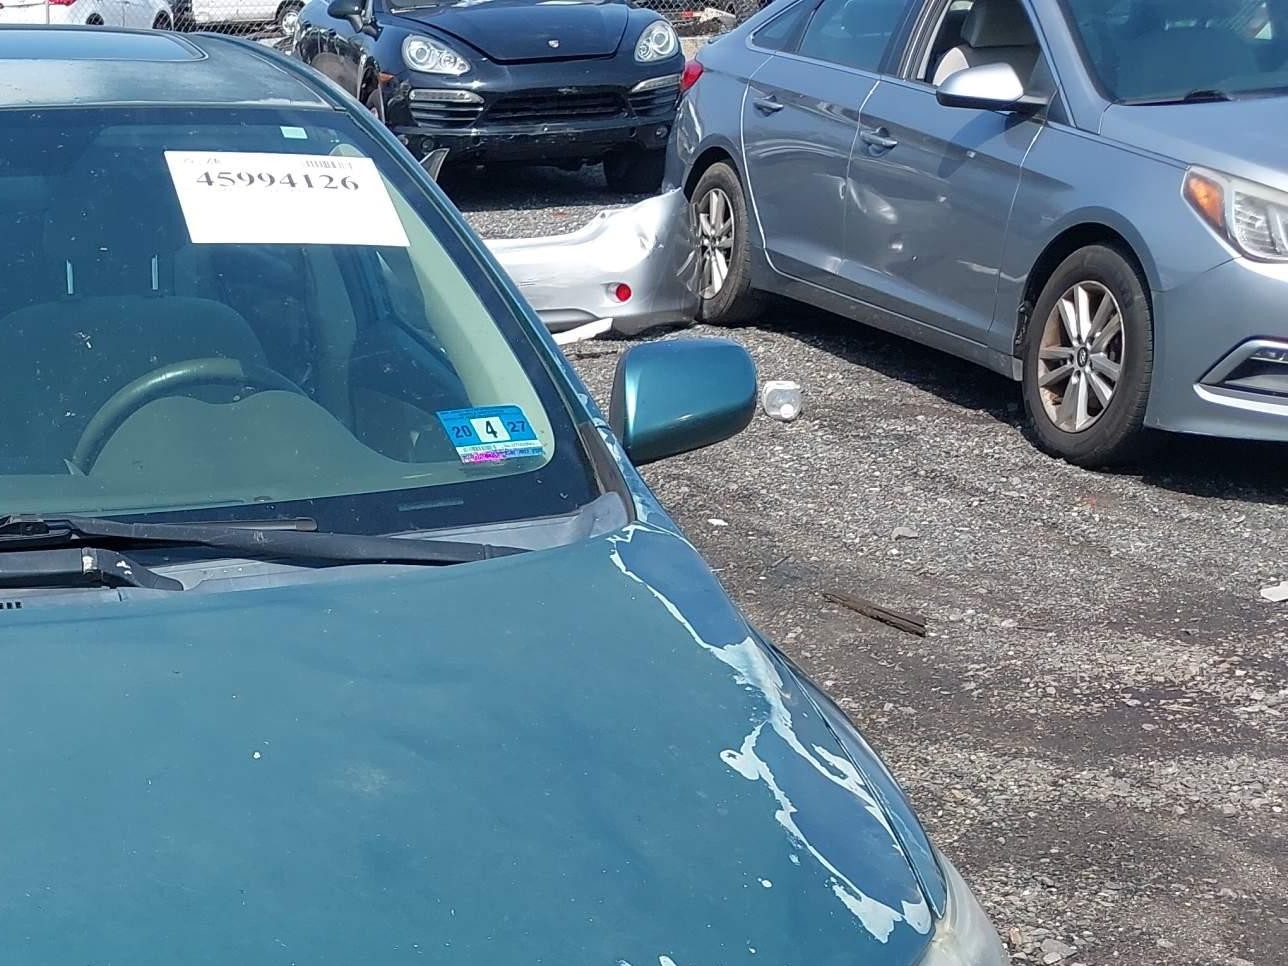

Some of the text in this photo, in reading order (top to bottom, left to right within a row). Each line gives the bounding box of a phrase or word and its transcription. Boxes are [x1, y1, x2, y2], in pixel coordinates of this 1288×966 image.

[196, 170, 359, 191] 45994126
[452, 420, 526, 439] 20 4 27
